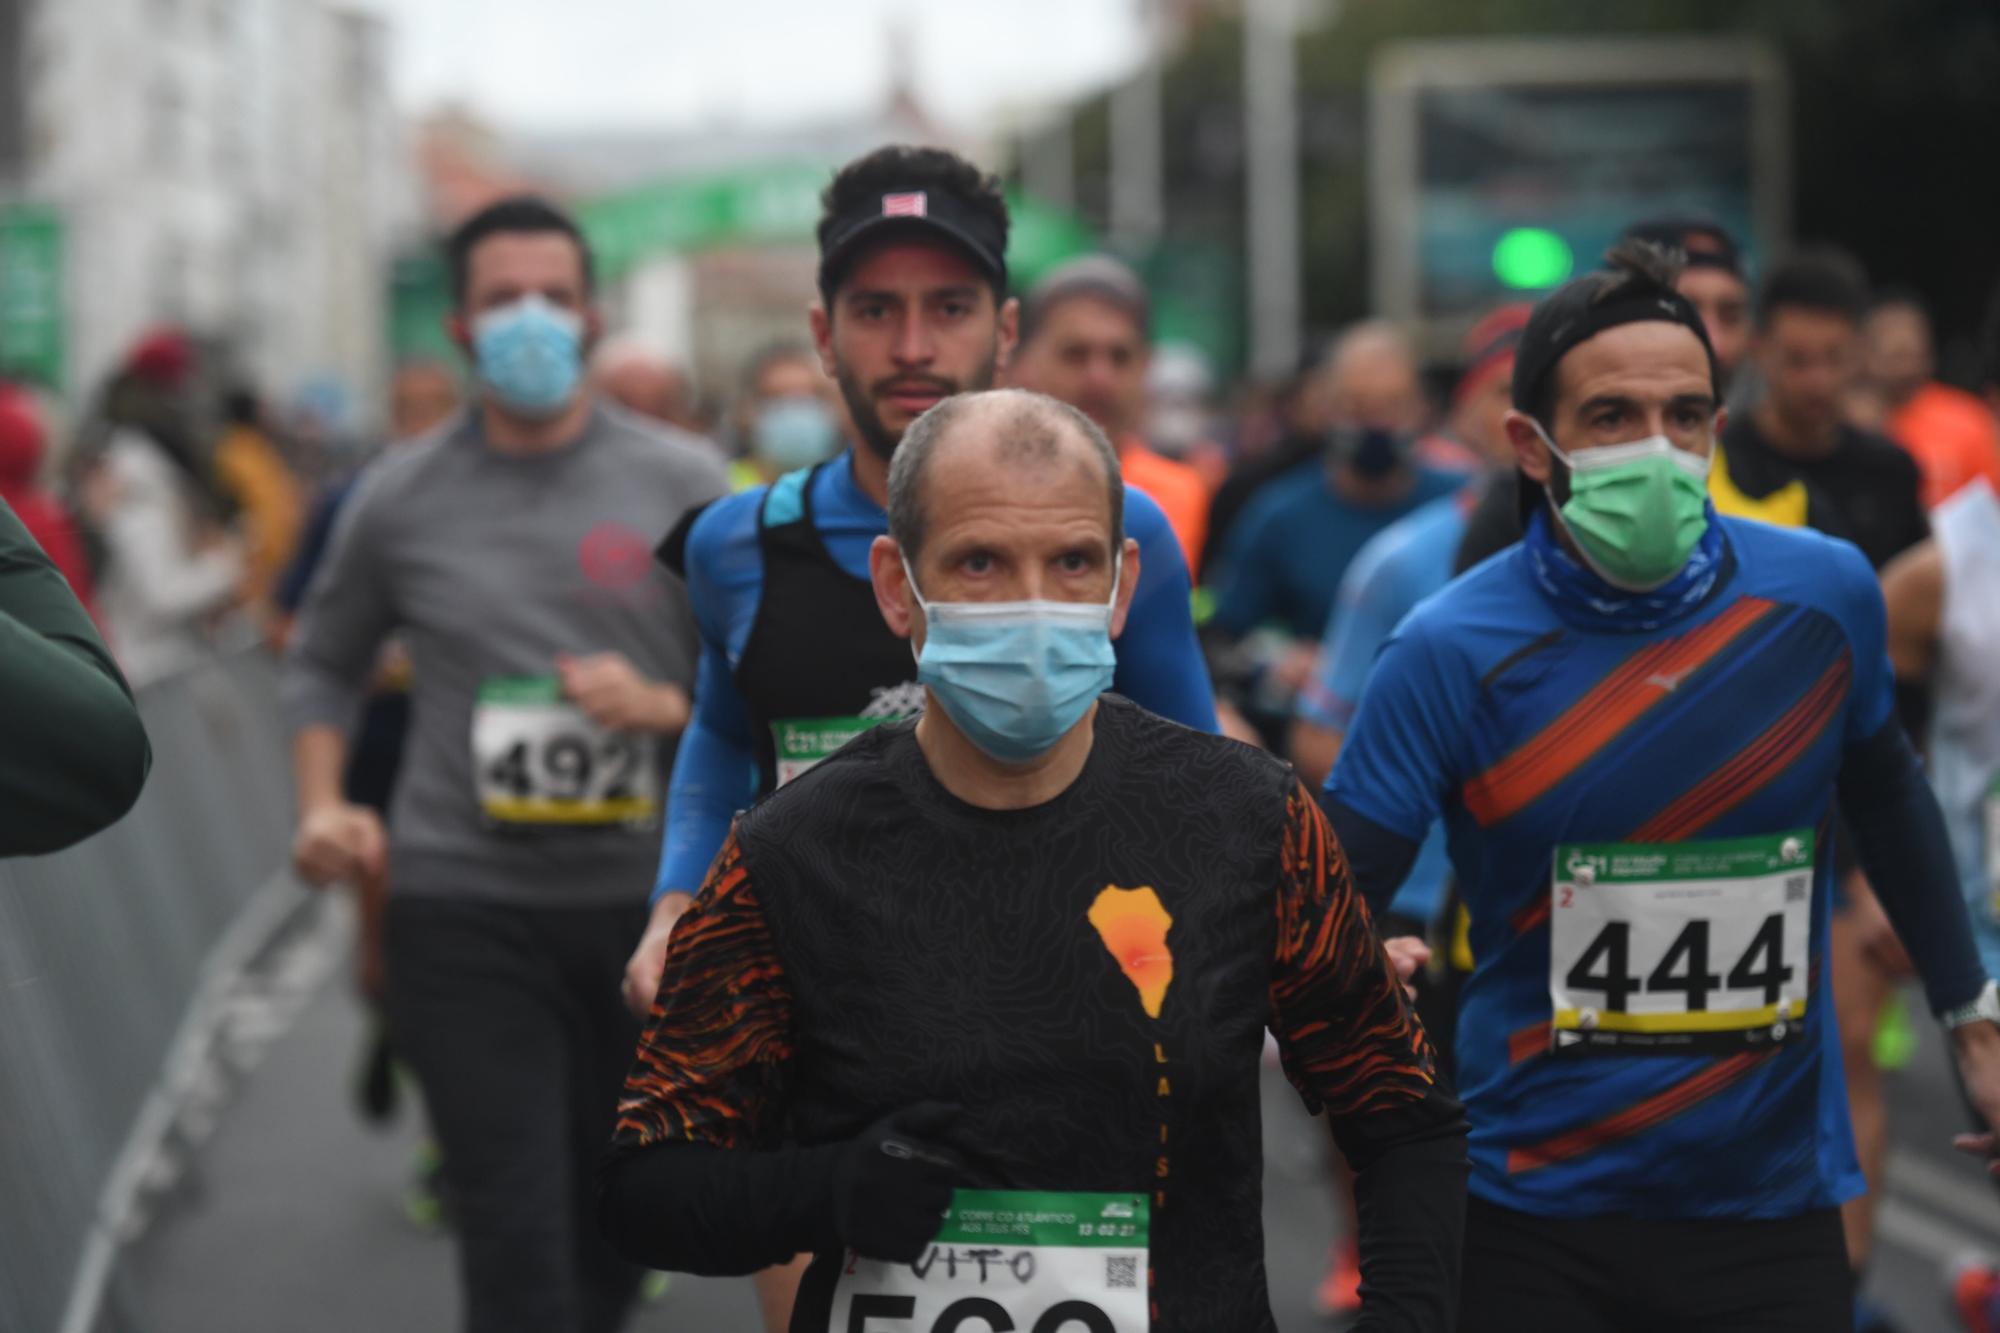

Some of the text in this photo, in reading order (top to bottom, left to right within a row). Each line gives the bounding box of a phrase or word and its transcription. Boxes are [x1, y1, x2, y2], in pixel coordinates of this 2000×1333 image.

[488, 733, 642, 803] 492
[1559, 886, 1574, 908] 2
[1566, 913, 1793, 1014] 444
